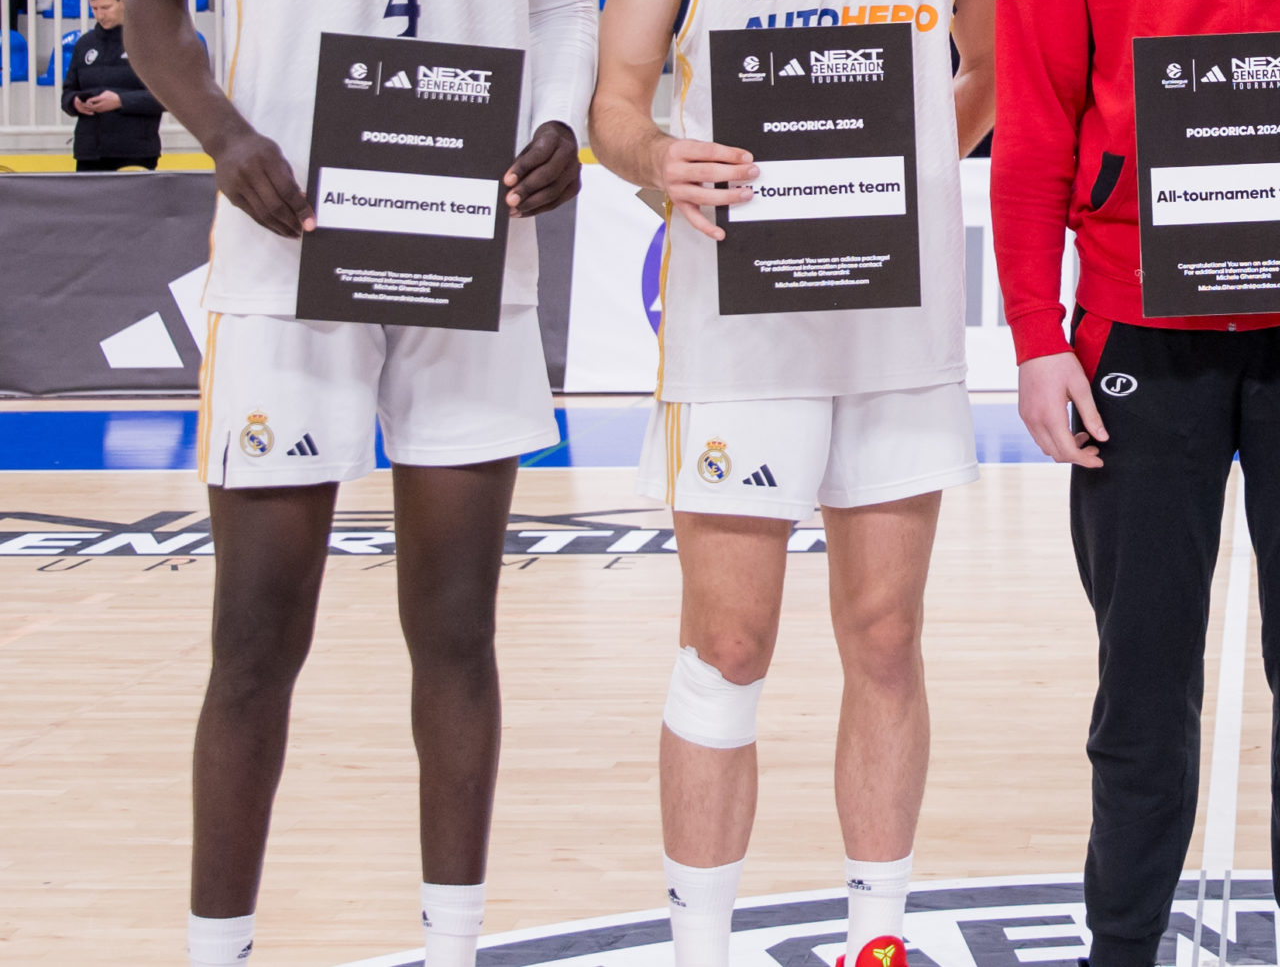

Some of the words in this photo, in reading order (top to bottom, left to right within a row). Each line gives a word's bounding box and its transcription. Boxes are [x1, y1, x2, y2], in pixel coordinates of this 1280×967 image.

[810, 48, 883, 62] NEXT
[418, 65, 492, 83] NEXT
[811, 61, 883, 74] GENERATION
[811, 73, 884, 83] TOURNAMENT
[418, 78, 490, 94] GENERATION
[416, 91, 489, 104] TOURNAMENT
[763, 119, 834, 132] PODGORICA
[836, 118, 864, 129] 2024
[1186, 125, 1255, 137] PODGORICA
[362, 131, 434, 146] PODGORICA
[435, 136, 464, 148] 2024
[736, 181, 854, 198] -tournament
[858, 180, 900, 193] team
[1156, 185, 1275, 202] All-tournament
[323, 190, 446, 212] All-tournament
[449, 201, 491, 215] team
